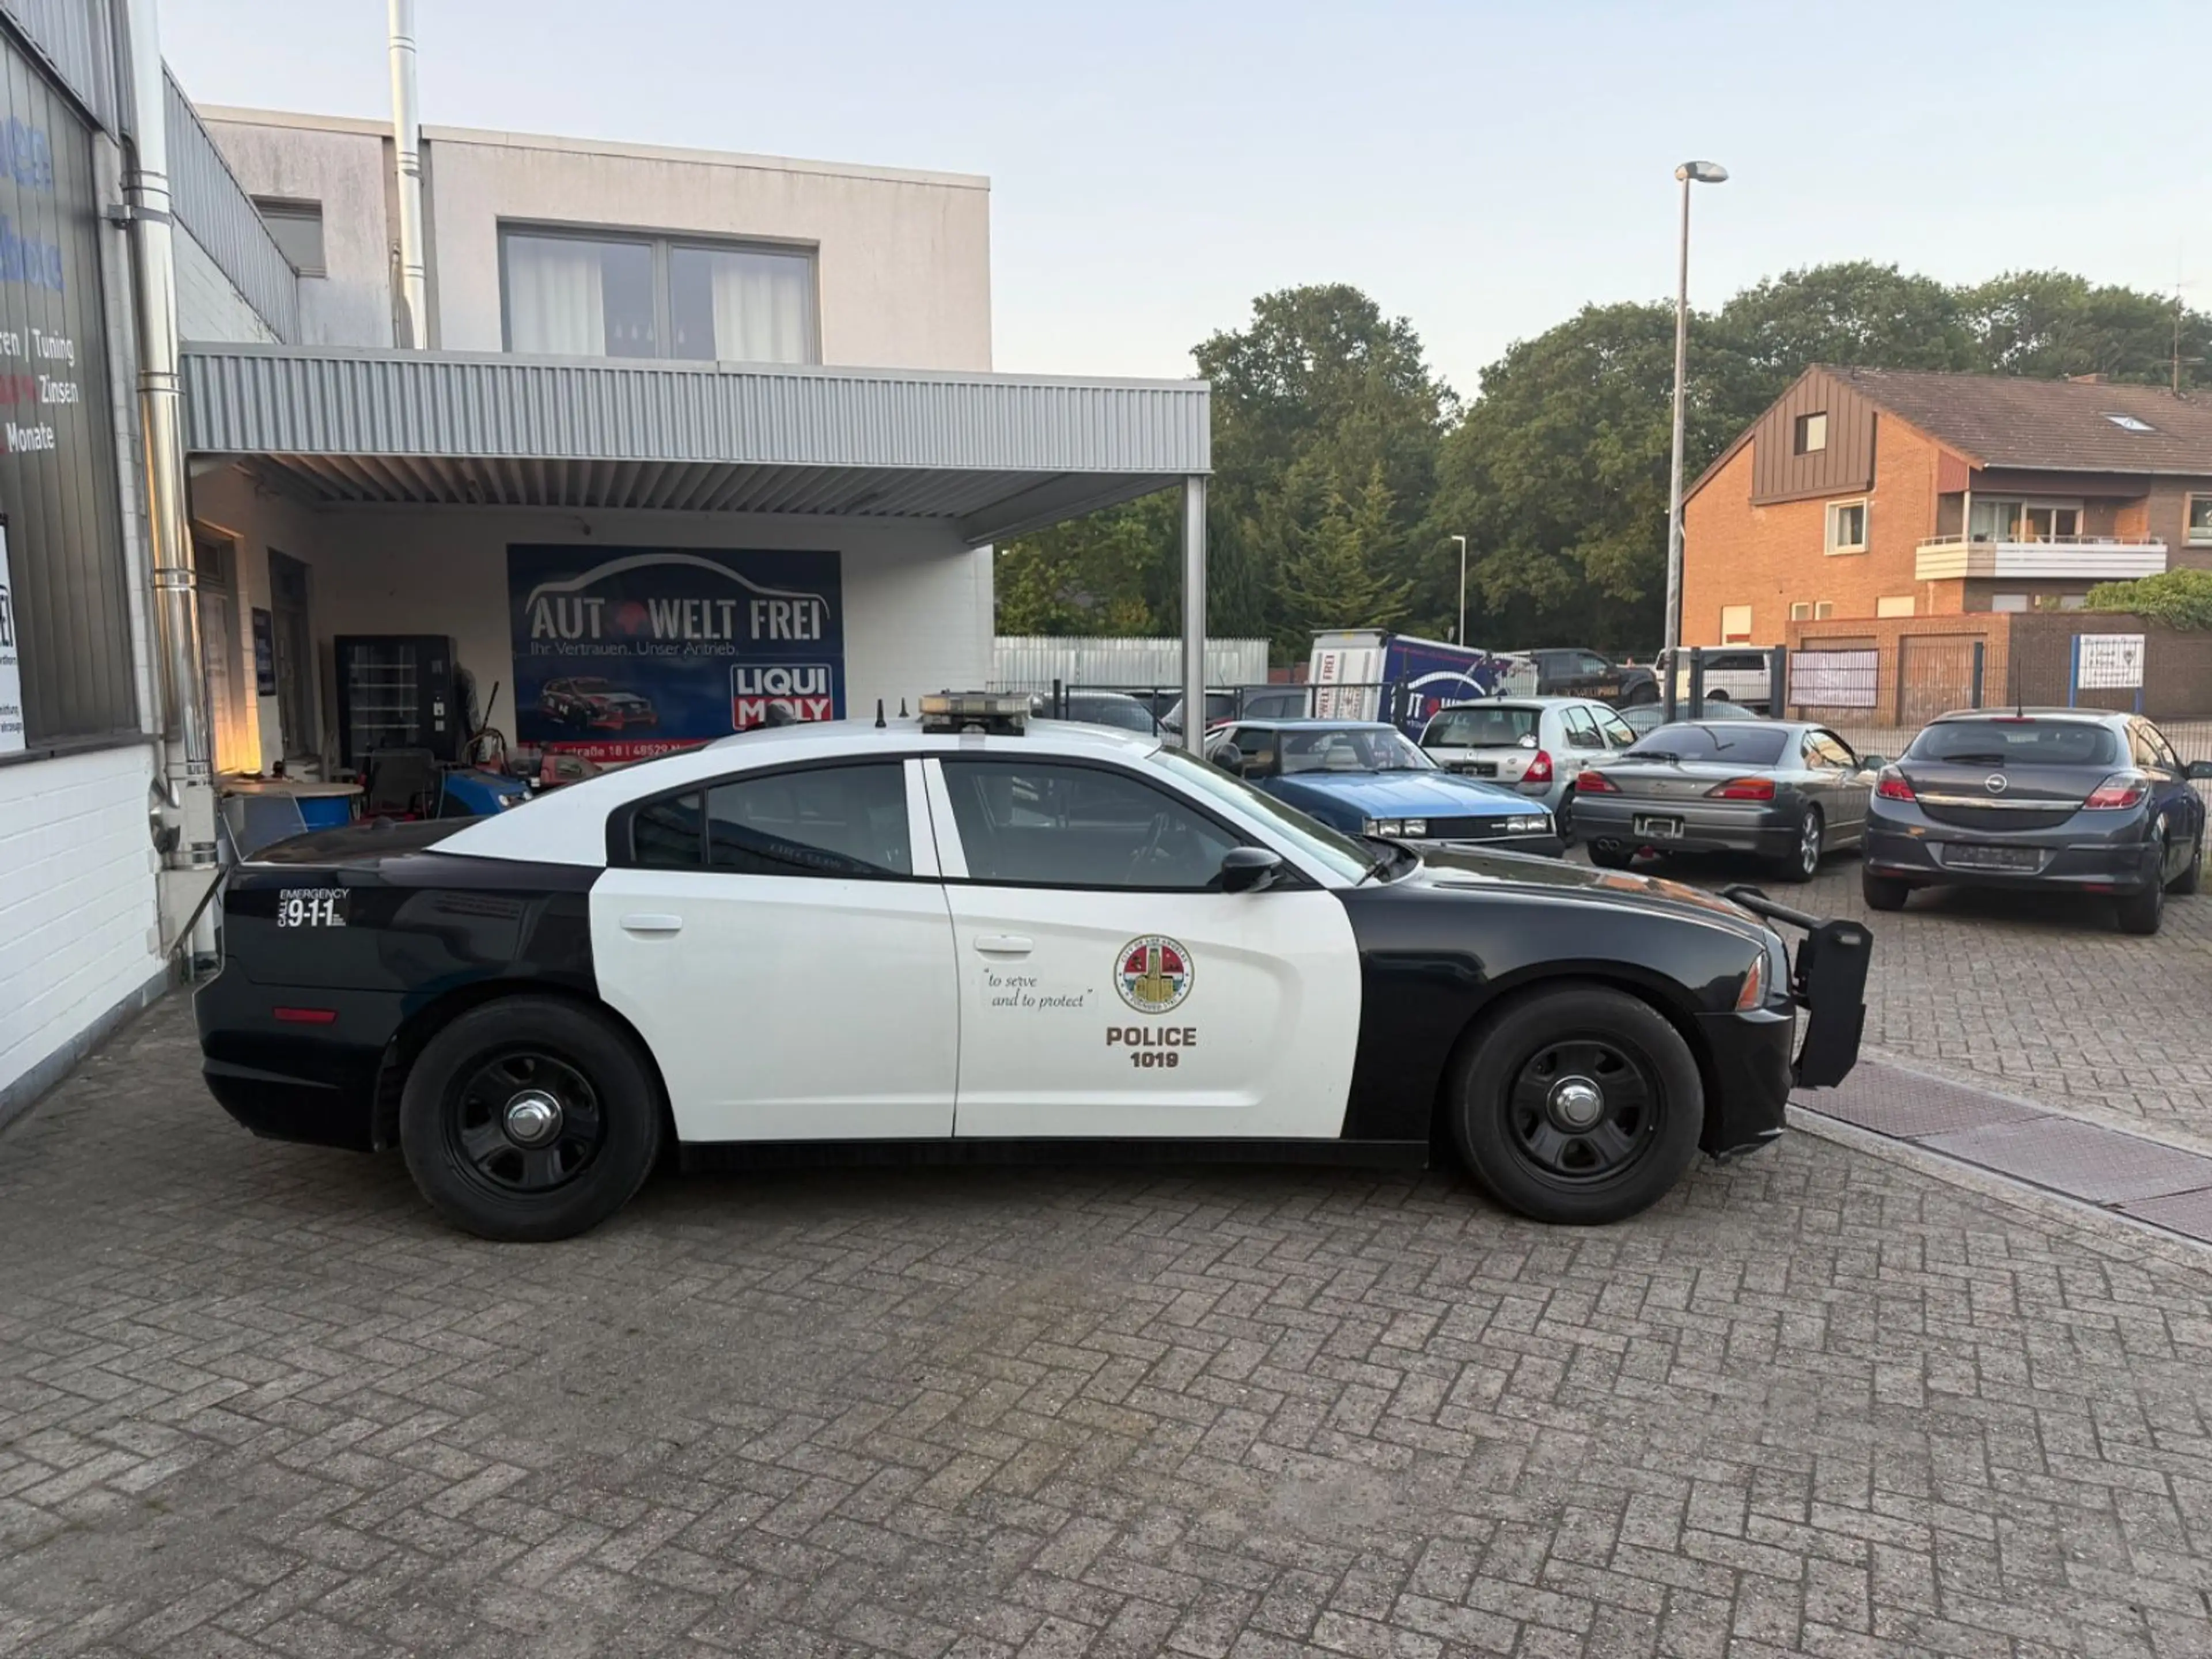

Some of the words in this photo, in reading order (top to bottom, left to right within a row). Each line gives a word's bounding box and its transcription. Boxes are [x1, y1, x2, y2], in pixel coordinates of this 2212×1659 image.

[31, 327, 75, 369] Tuning
[38, 374, 79, 403] Zinsen
[5, 421, 55, 453] Monate
[750, 600, 821, 640] FREI
[530, 642, 551, 656] Ihr
[554, 642, 632, 656] Vertrauen.
[636, 641, 680, 656] Unser
[737, 668, 827, 695] LIQUI
[279, 888, 350, 900] EMERGENCY
[288, 899, 334, 927] 9-1-1
[1005, 976, 1037, 987] serve
[992, 987, 1020, 1007] and
[1022, 993, 1036, 1007] to
[1106, 1027, 1197, 1046] POLICE
